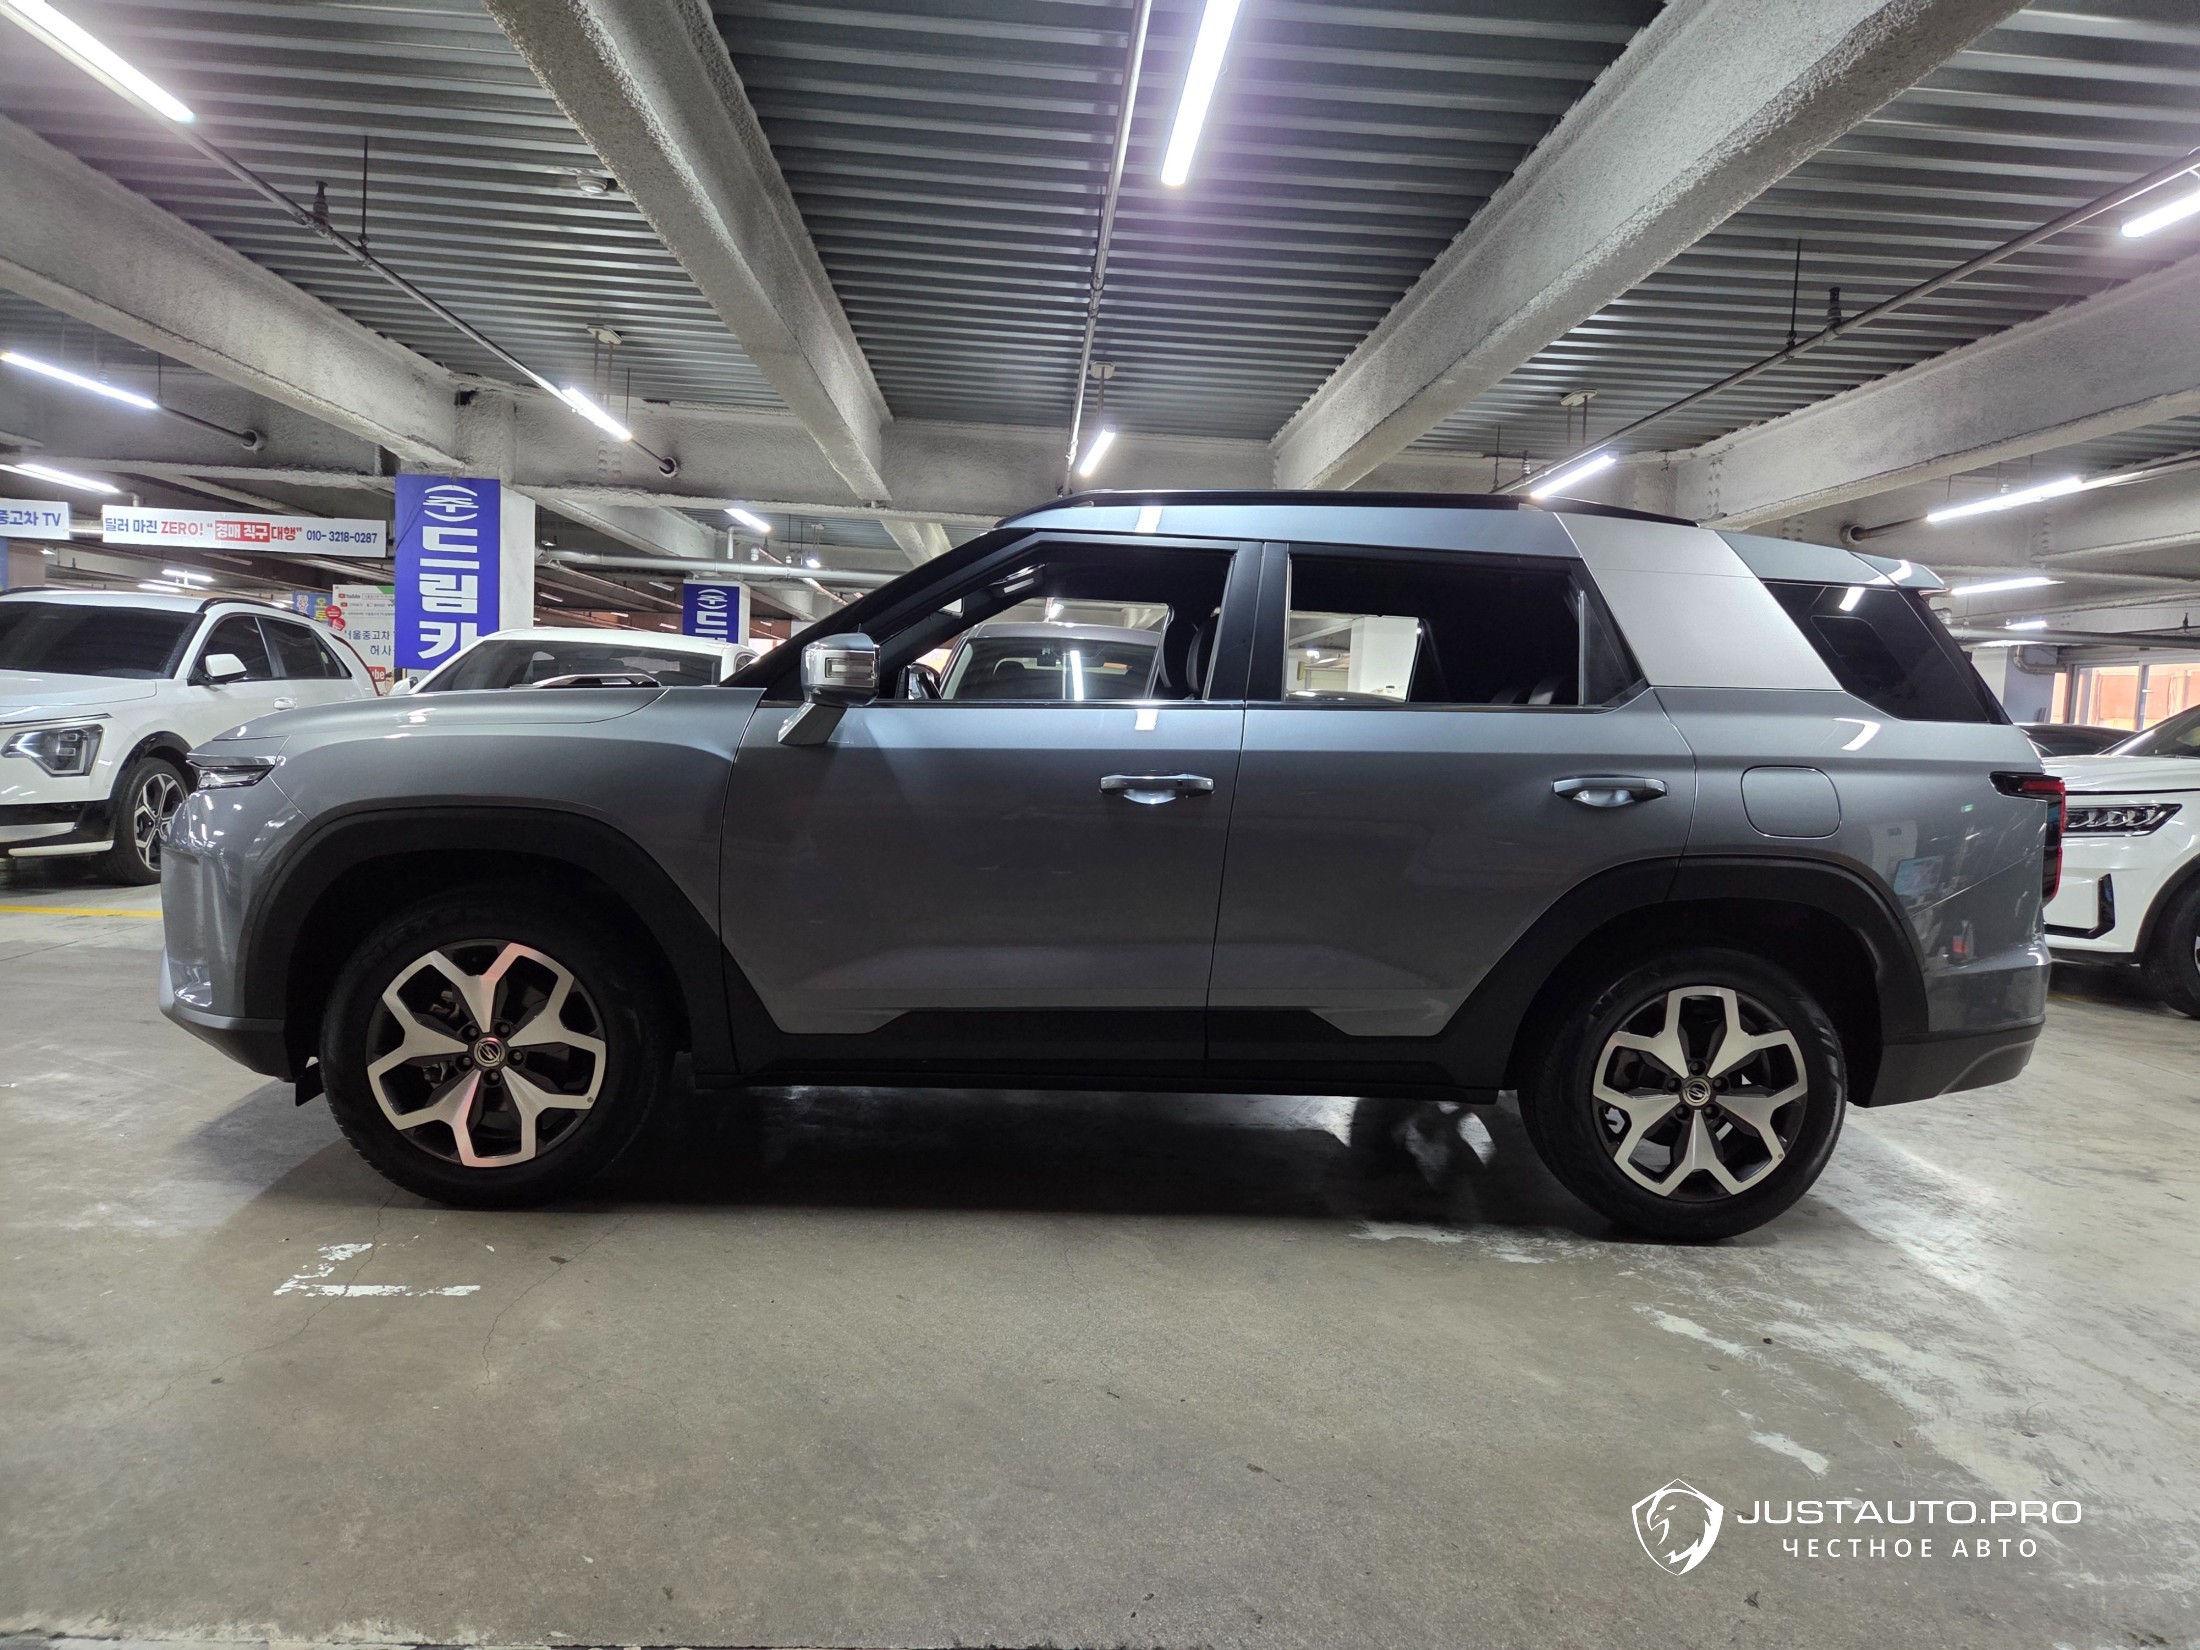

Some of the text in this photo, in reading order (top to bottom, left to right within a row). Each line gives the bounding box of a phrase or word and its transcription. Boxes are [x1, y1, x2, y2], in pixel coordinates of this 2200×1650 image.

[42, 512, 61, 527] TV
[105, 517, 129, 532] 딜러
[133, 519, 157, 534] 마진
[161, 521, 203, 536] ZERO!
[695, 588, 729, 642] (주)드
[370, 645, 394, 656] 허사
